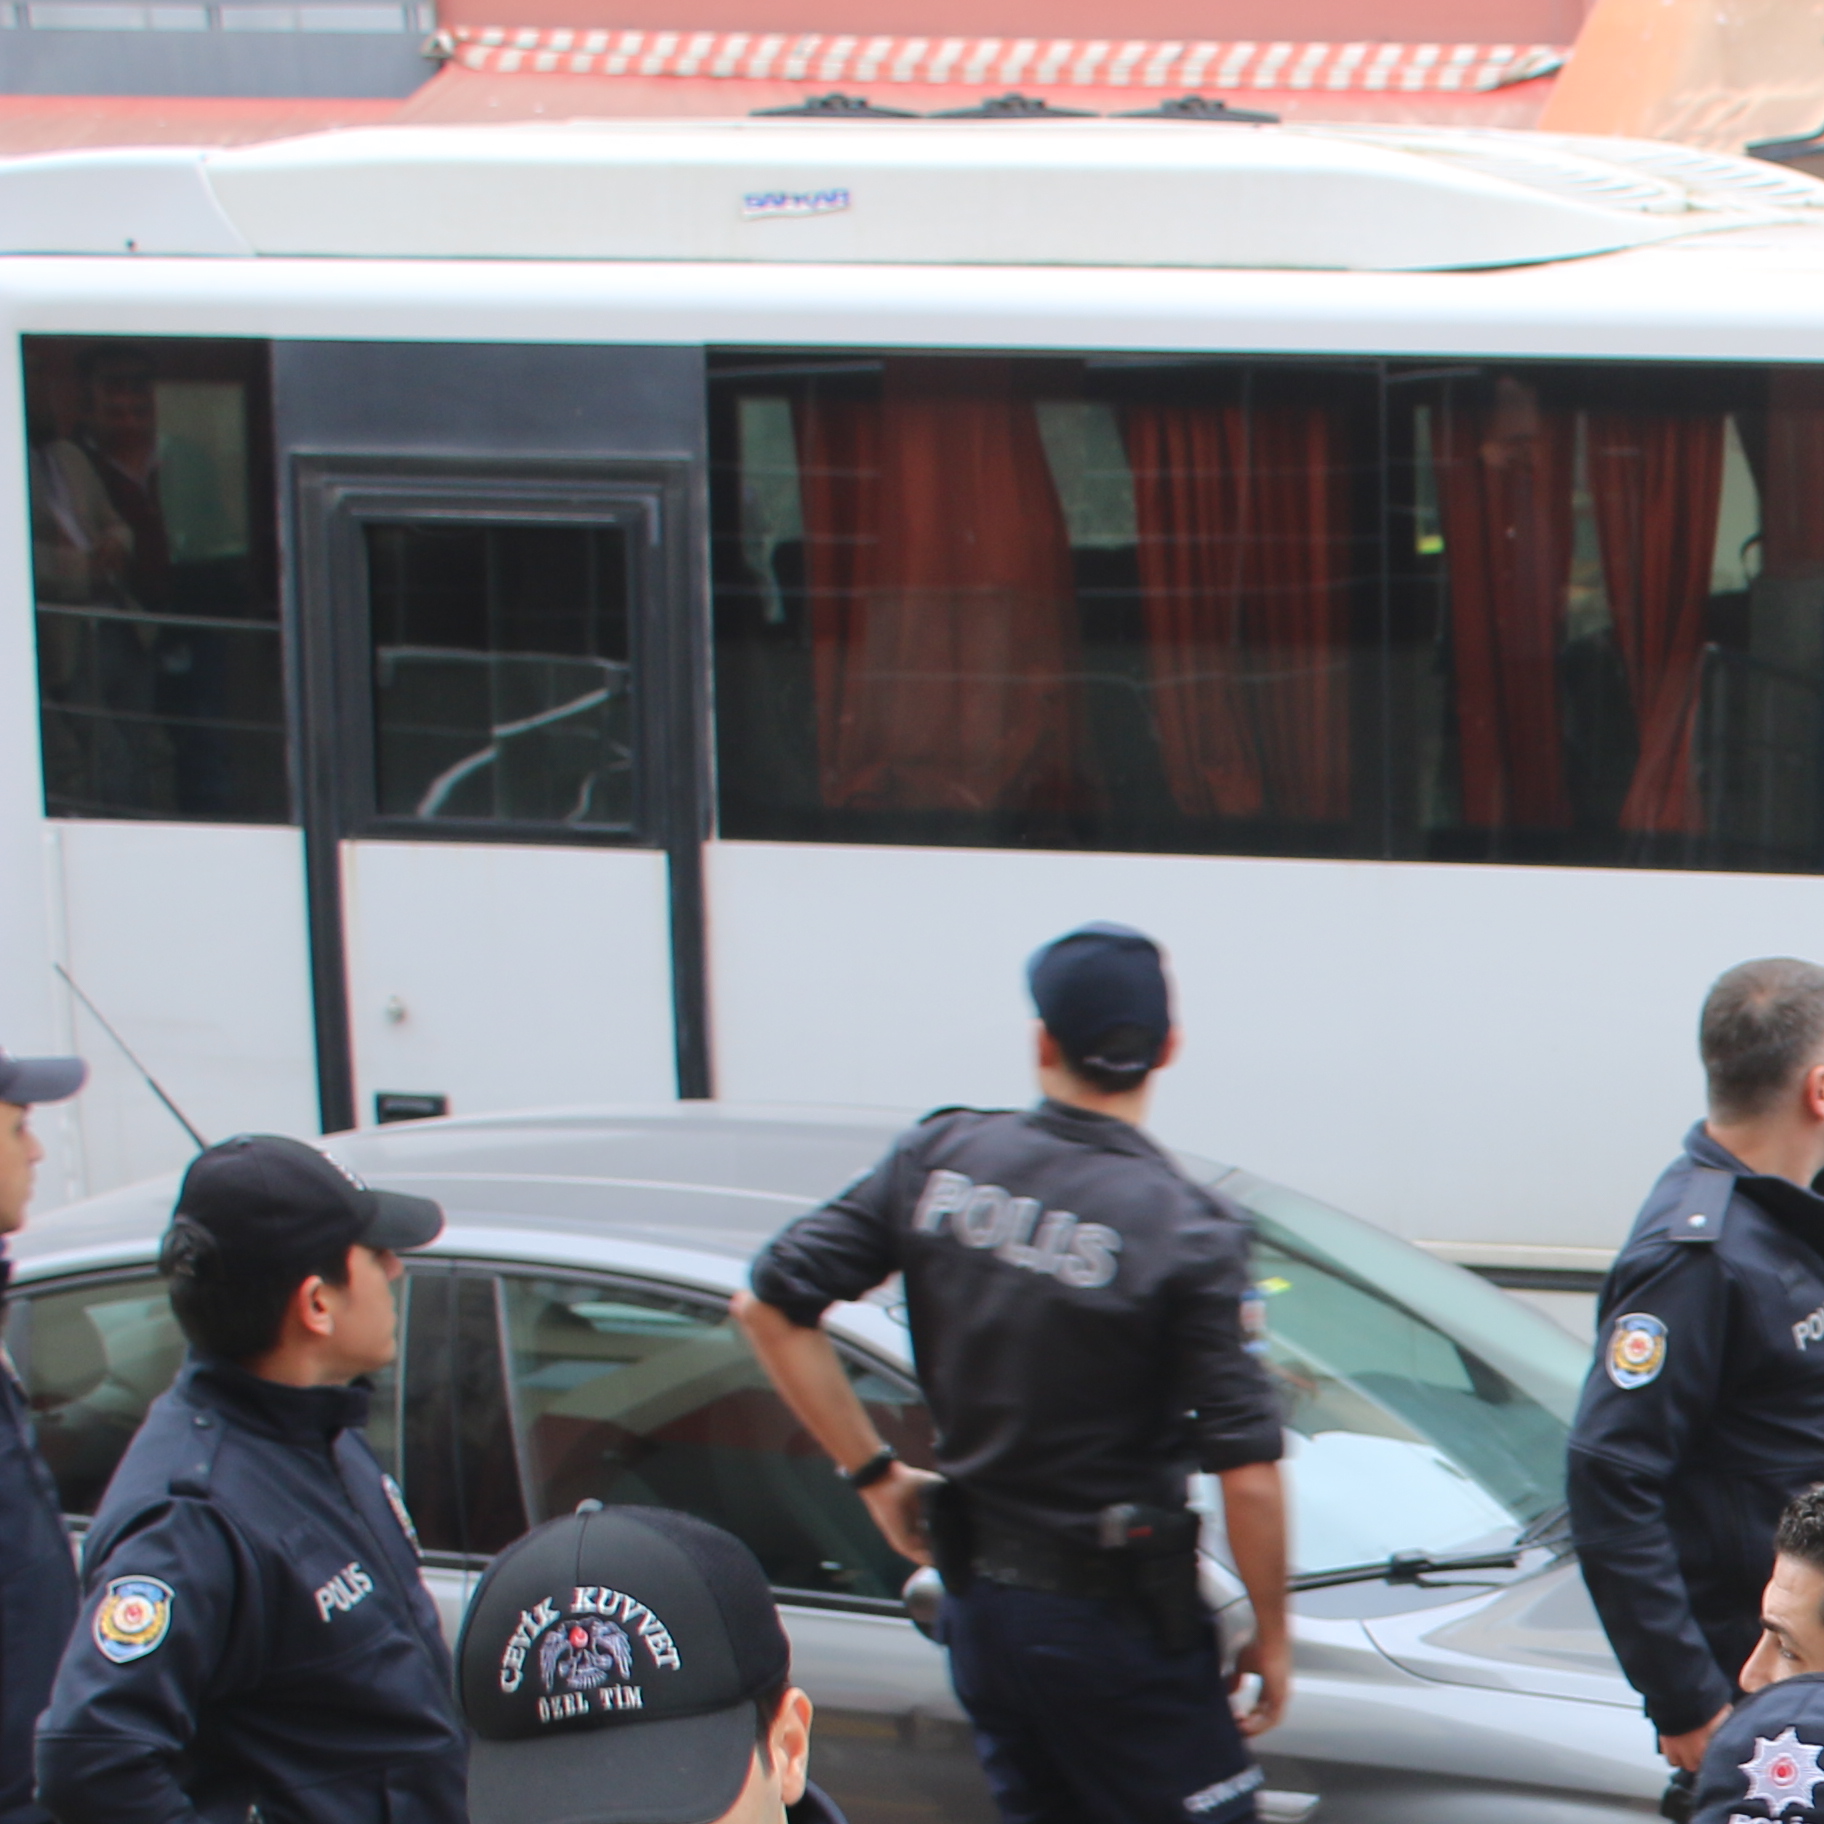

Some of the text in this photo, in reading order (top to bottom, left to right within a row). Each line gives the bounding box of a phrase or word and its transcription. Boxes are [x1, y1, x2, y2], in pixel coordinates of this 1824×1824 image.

[912, 1168, 1122, 1288] POLİS
[570, 1586, 682, 1671] KUVVET
[600, 1683, 643, 1711] TİM
